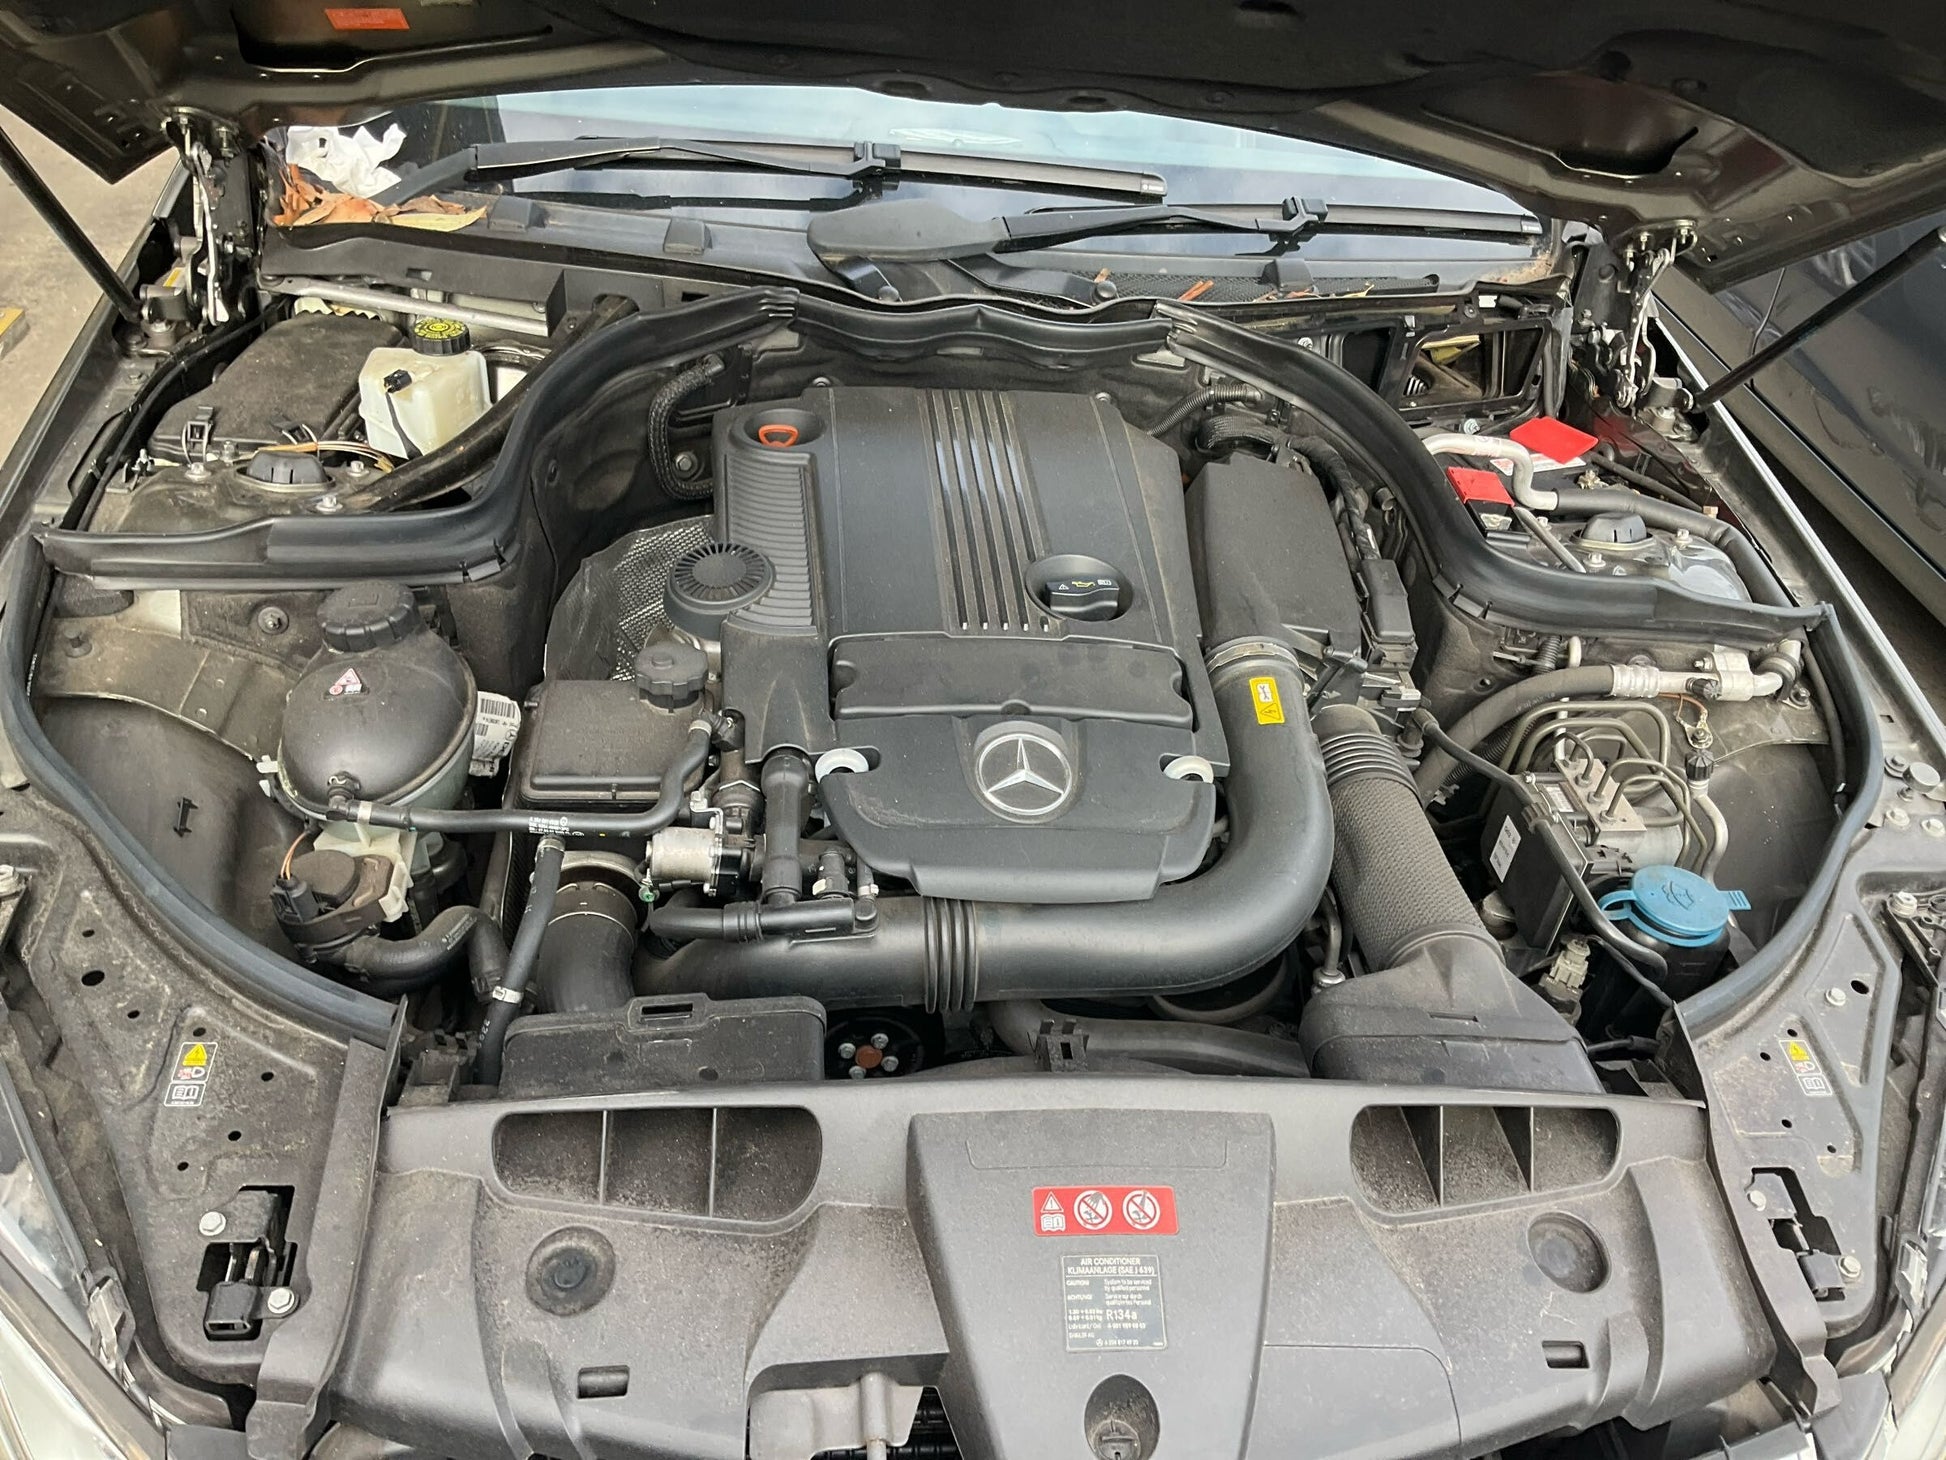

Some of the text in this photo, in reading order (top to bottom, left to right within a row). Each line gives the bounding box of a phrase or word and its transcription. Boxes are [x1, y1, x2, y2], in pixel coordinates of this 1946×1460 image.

[1081, 1257, 1141, 1266] AIR CONDITIONER
[1067, 1266, 1117, 1274] KLIMAANLAGE
[1118, 1266, 1133, 1275] (SAE
[1105, 1309, 1138, 1321] R134a
